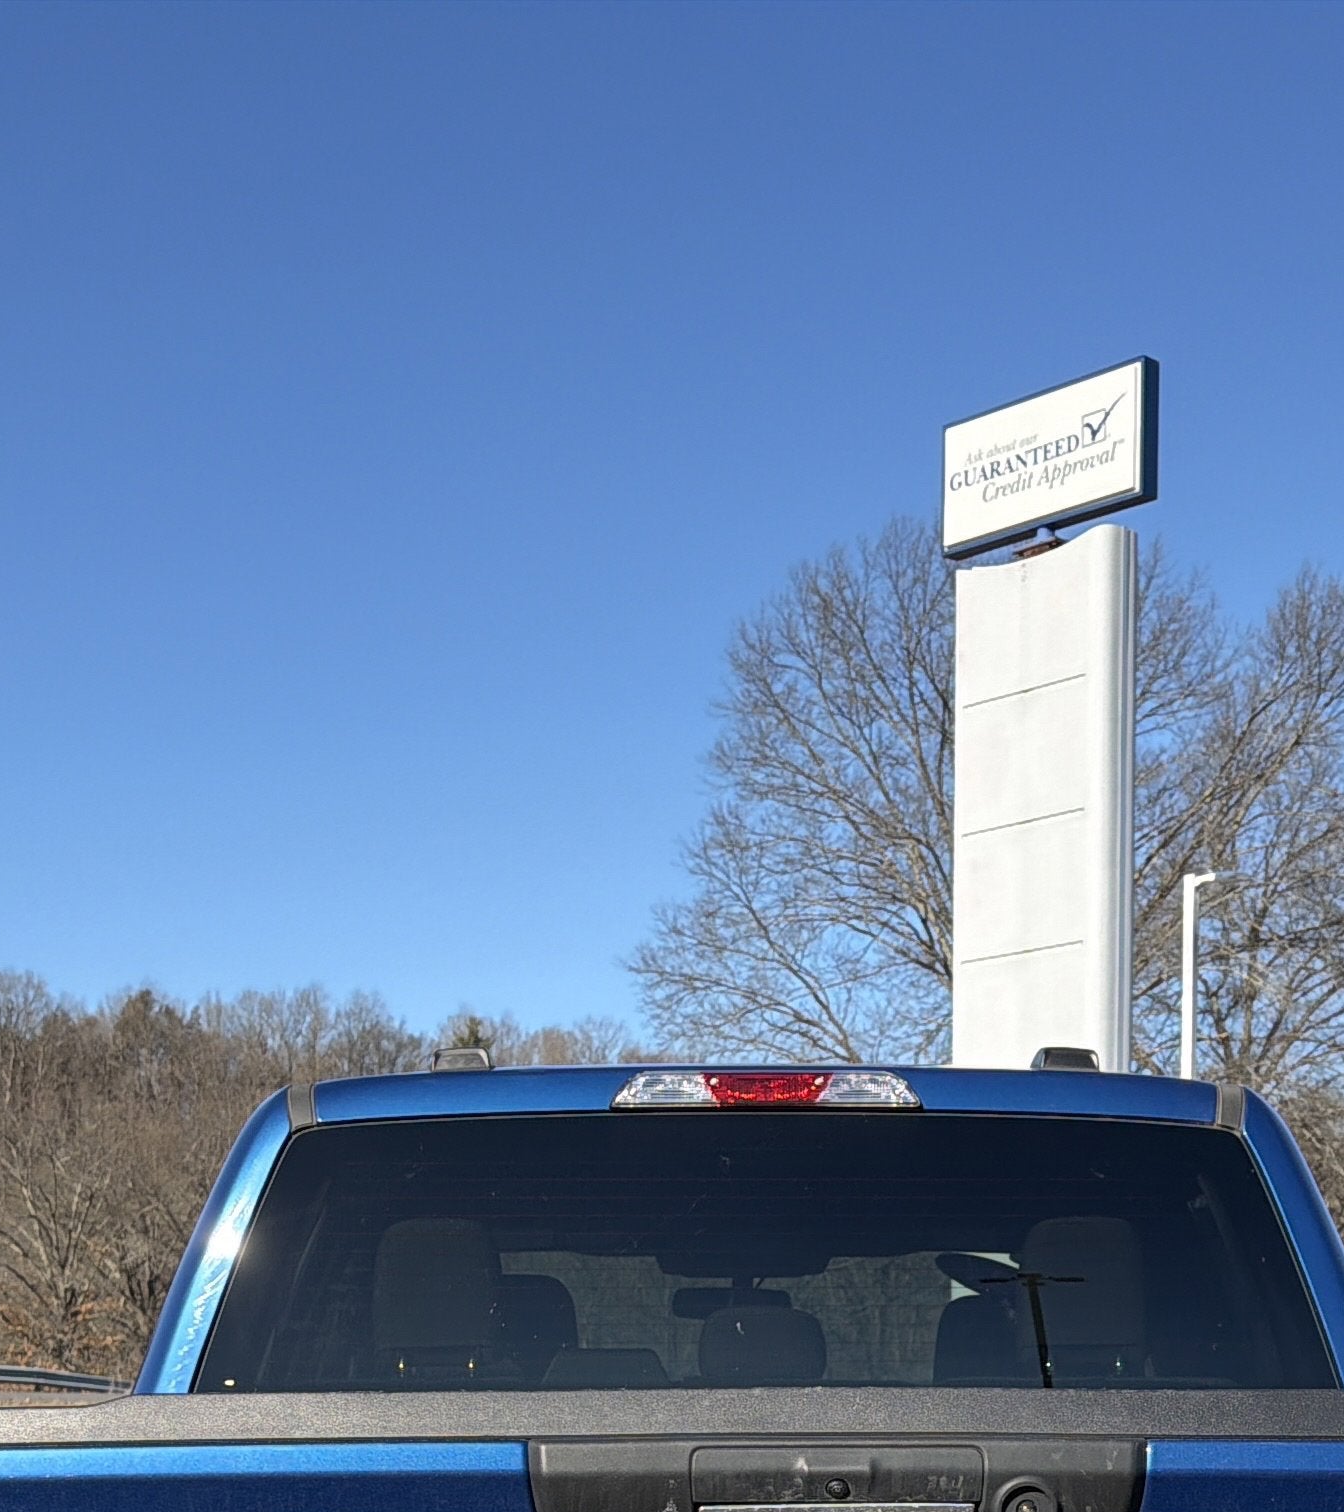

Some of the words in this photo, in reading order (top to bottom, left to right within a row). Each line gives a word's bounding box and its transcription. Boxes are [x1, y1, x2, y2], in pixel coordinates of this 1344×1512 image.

[949, 434, 1080, 492] GUARANTEED
[964, 449, 984, 466] Ask
[986, 438, 1017, 460] about
[1019, 433, 1039, 448] our
[982, 472, 1034, 503] Credit
[1037, 440, 1119, 489] Approval
